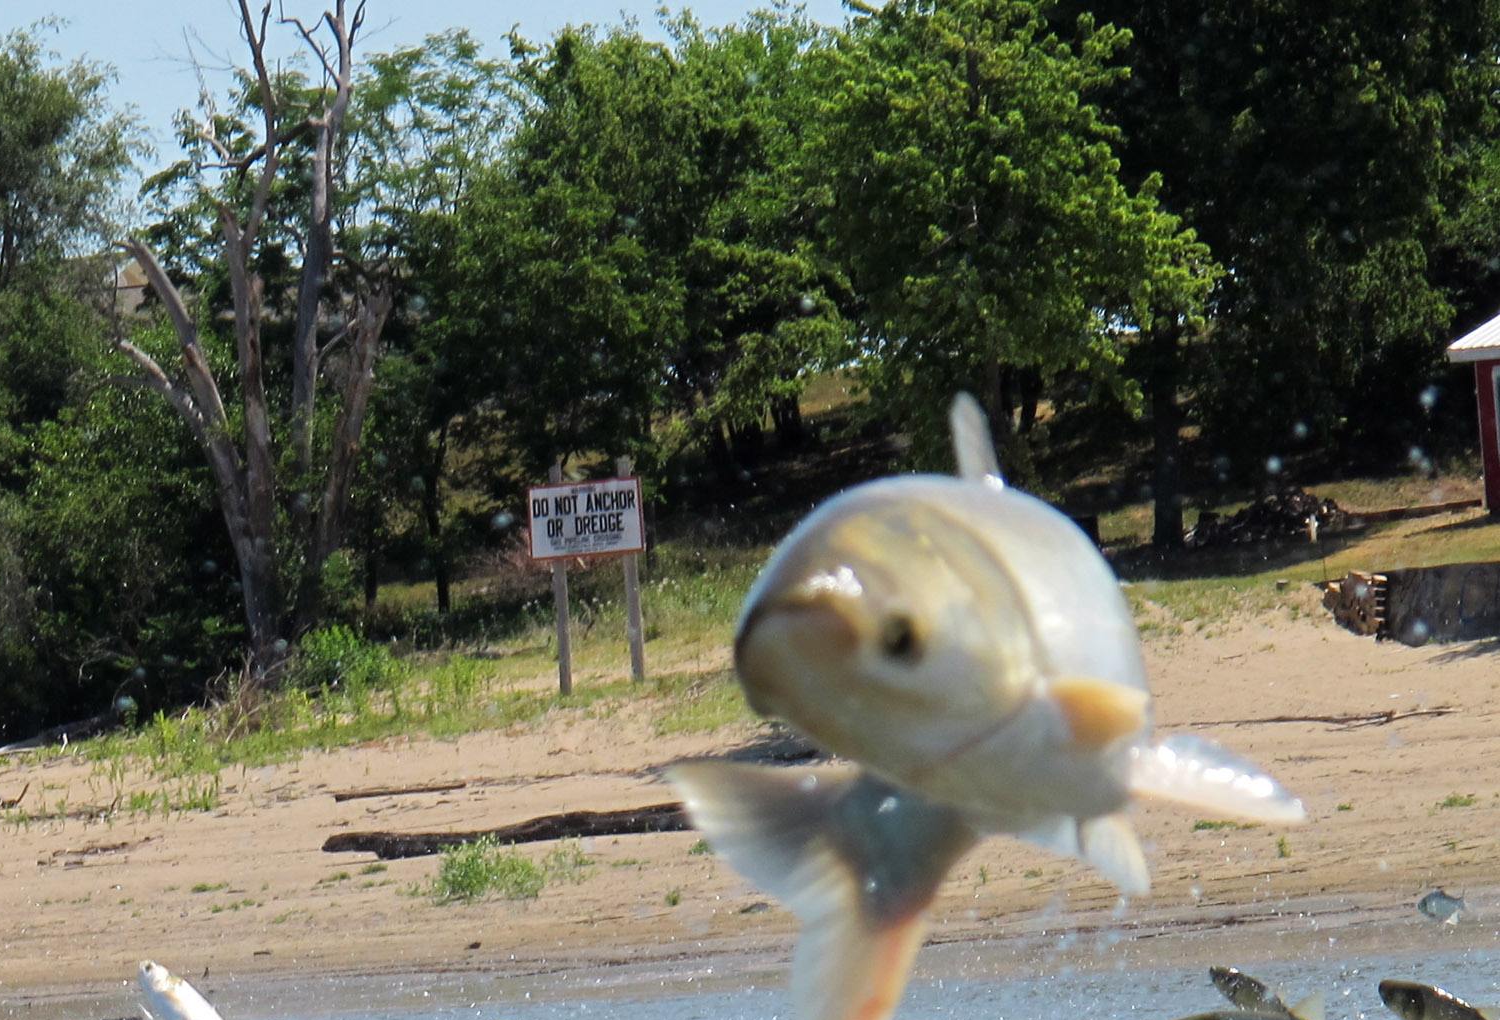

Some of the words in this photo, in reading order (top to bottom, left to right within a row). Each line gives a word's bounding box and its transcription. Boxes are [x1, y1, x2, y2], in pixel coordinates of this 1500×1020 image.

[532, 498, 549, 518] DO
[554, 495, 578, 516] NOT
[586, 490, 635, 513] ANCHOR
[547, 518, 563, 538] OR
[575, 512, 625, 536] DREDGE
